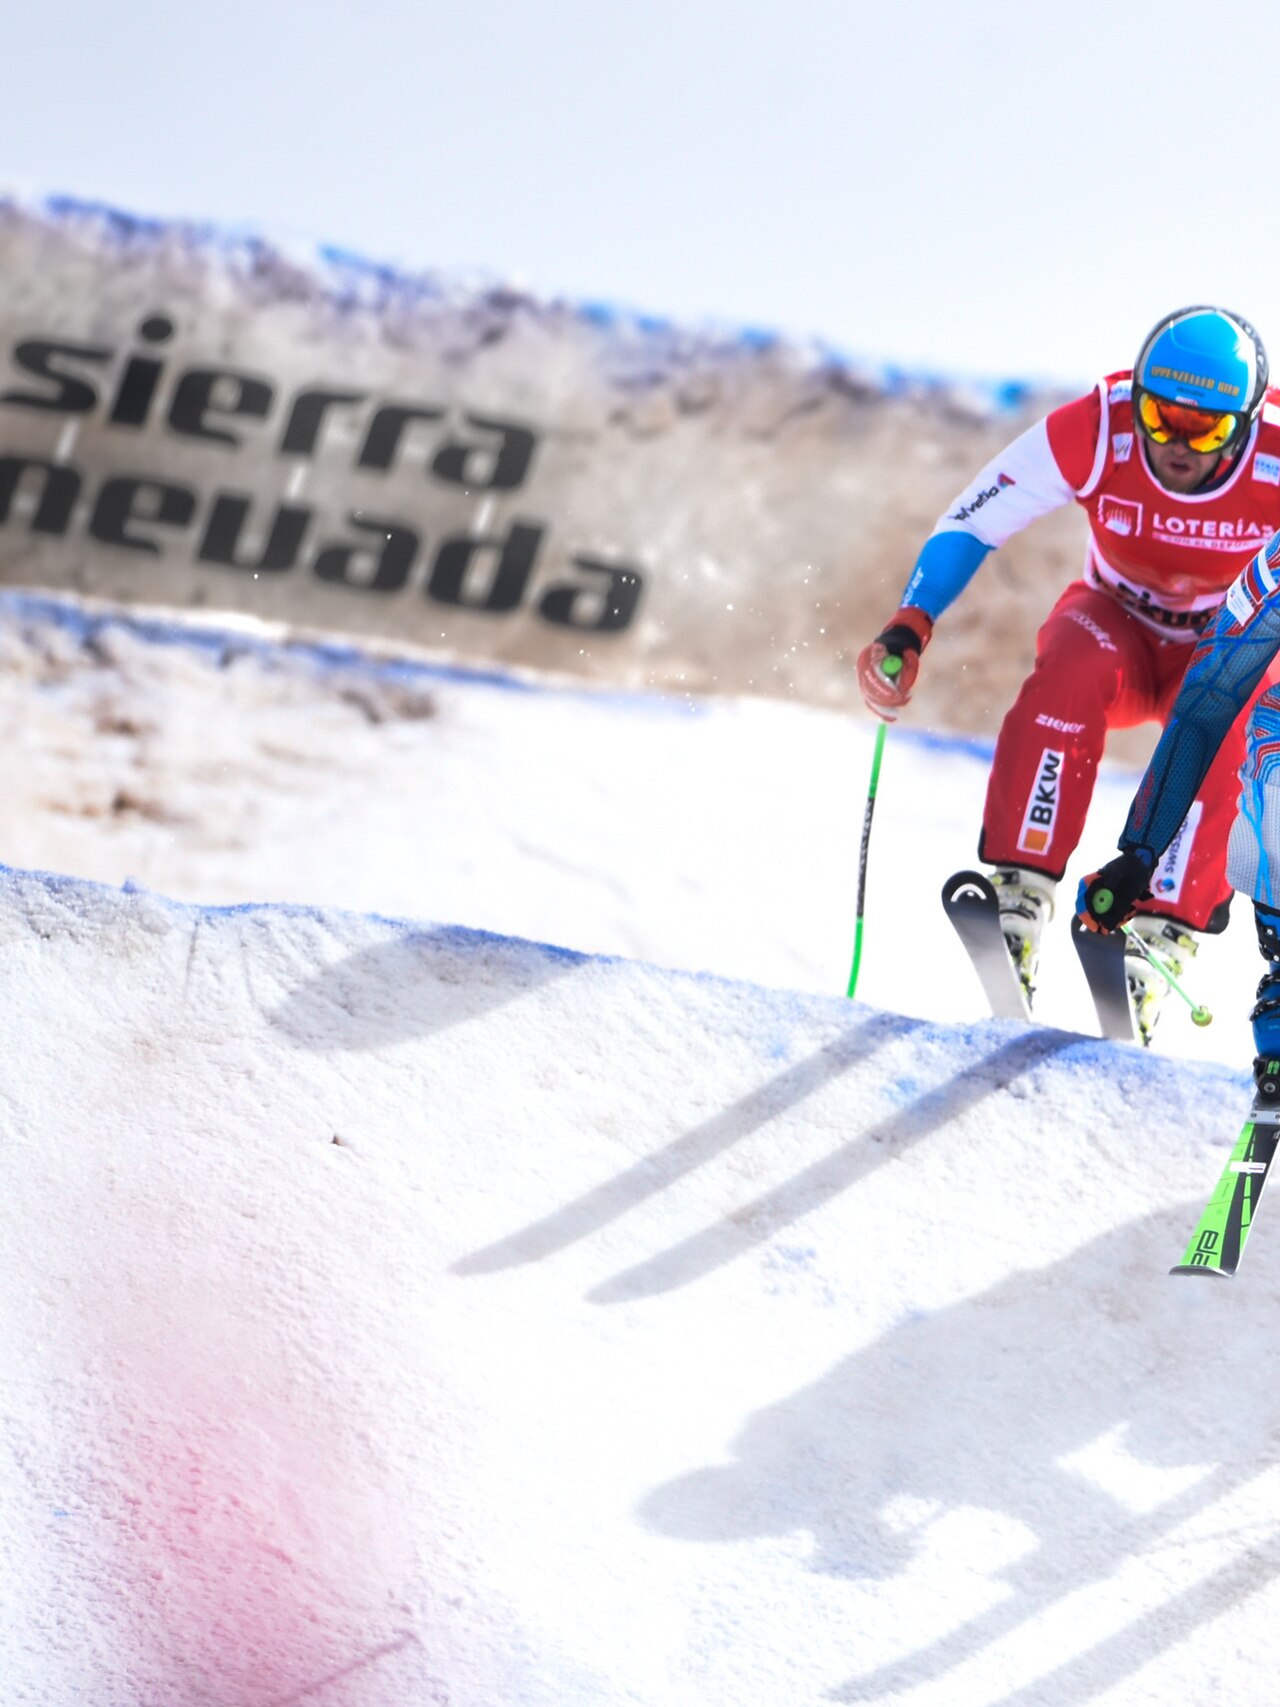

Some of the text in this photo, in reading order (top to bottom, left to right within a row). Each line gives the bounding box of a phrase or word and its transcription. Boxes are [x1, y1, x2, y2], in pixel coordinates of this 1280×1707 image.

[0, 315, 538, 491] sierra
[1152, 513, 1275, 538] LOTERÍAS
[1029, 752, 1060, 826] BKW
